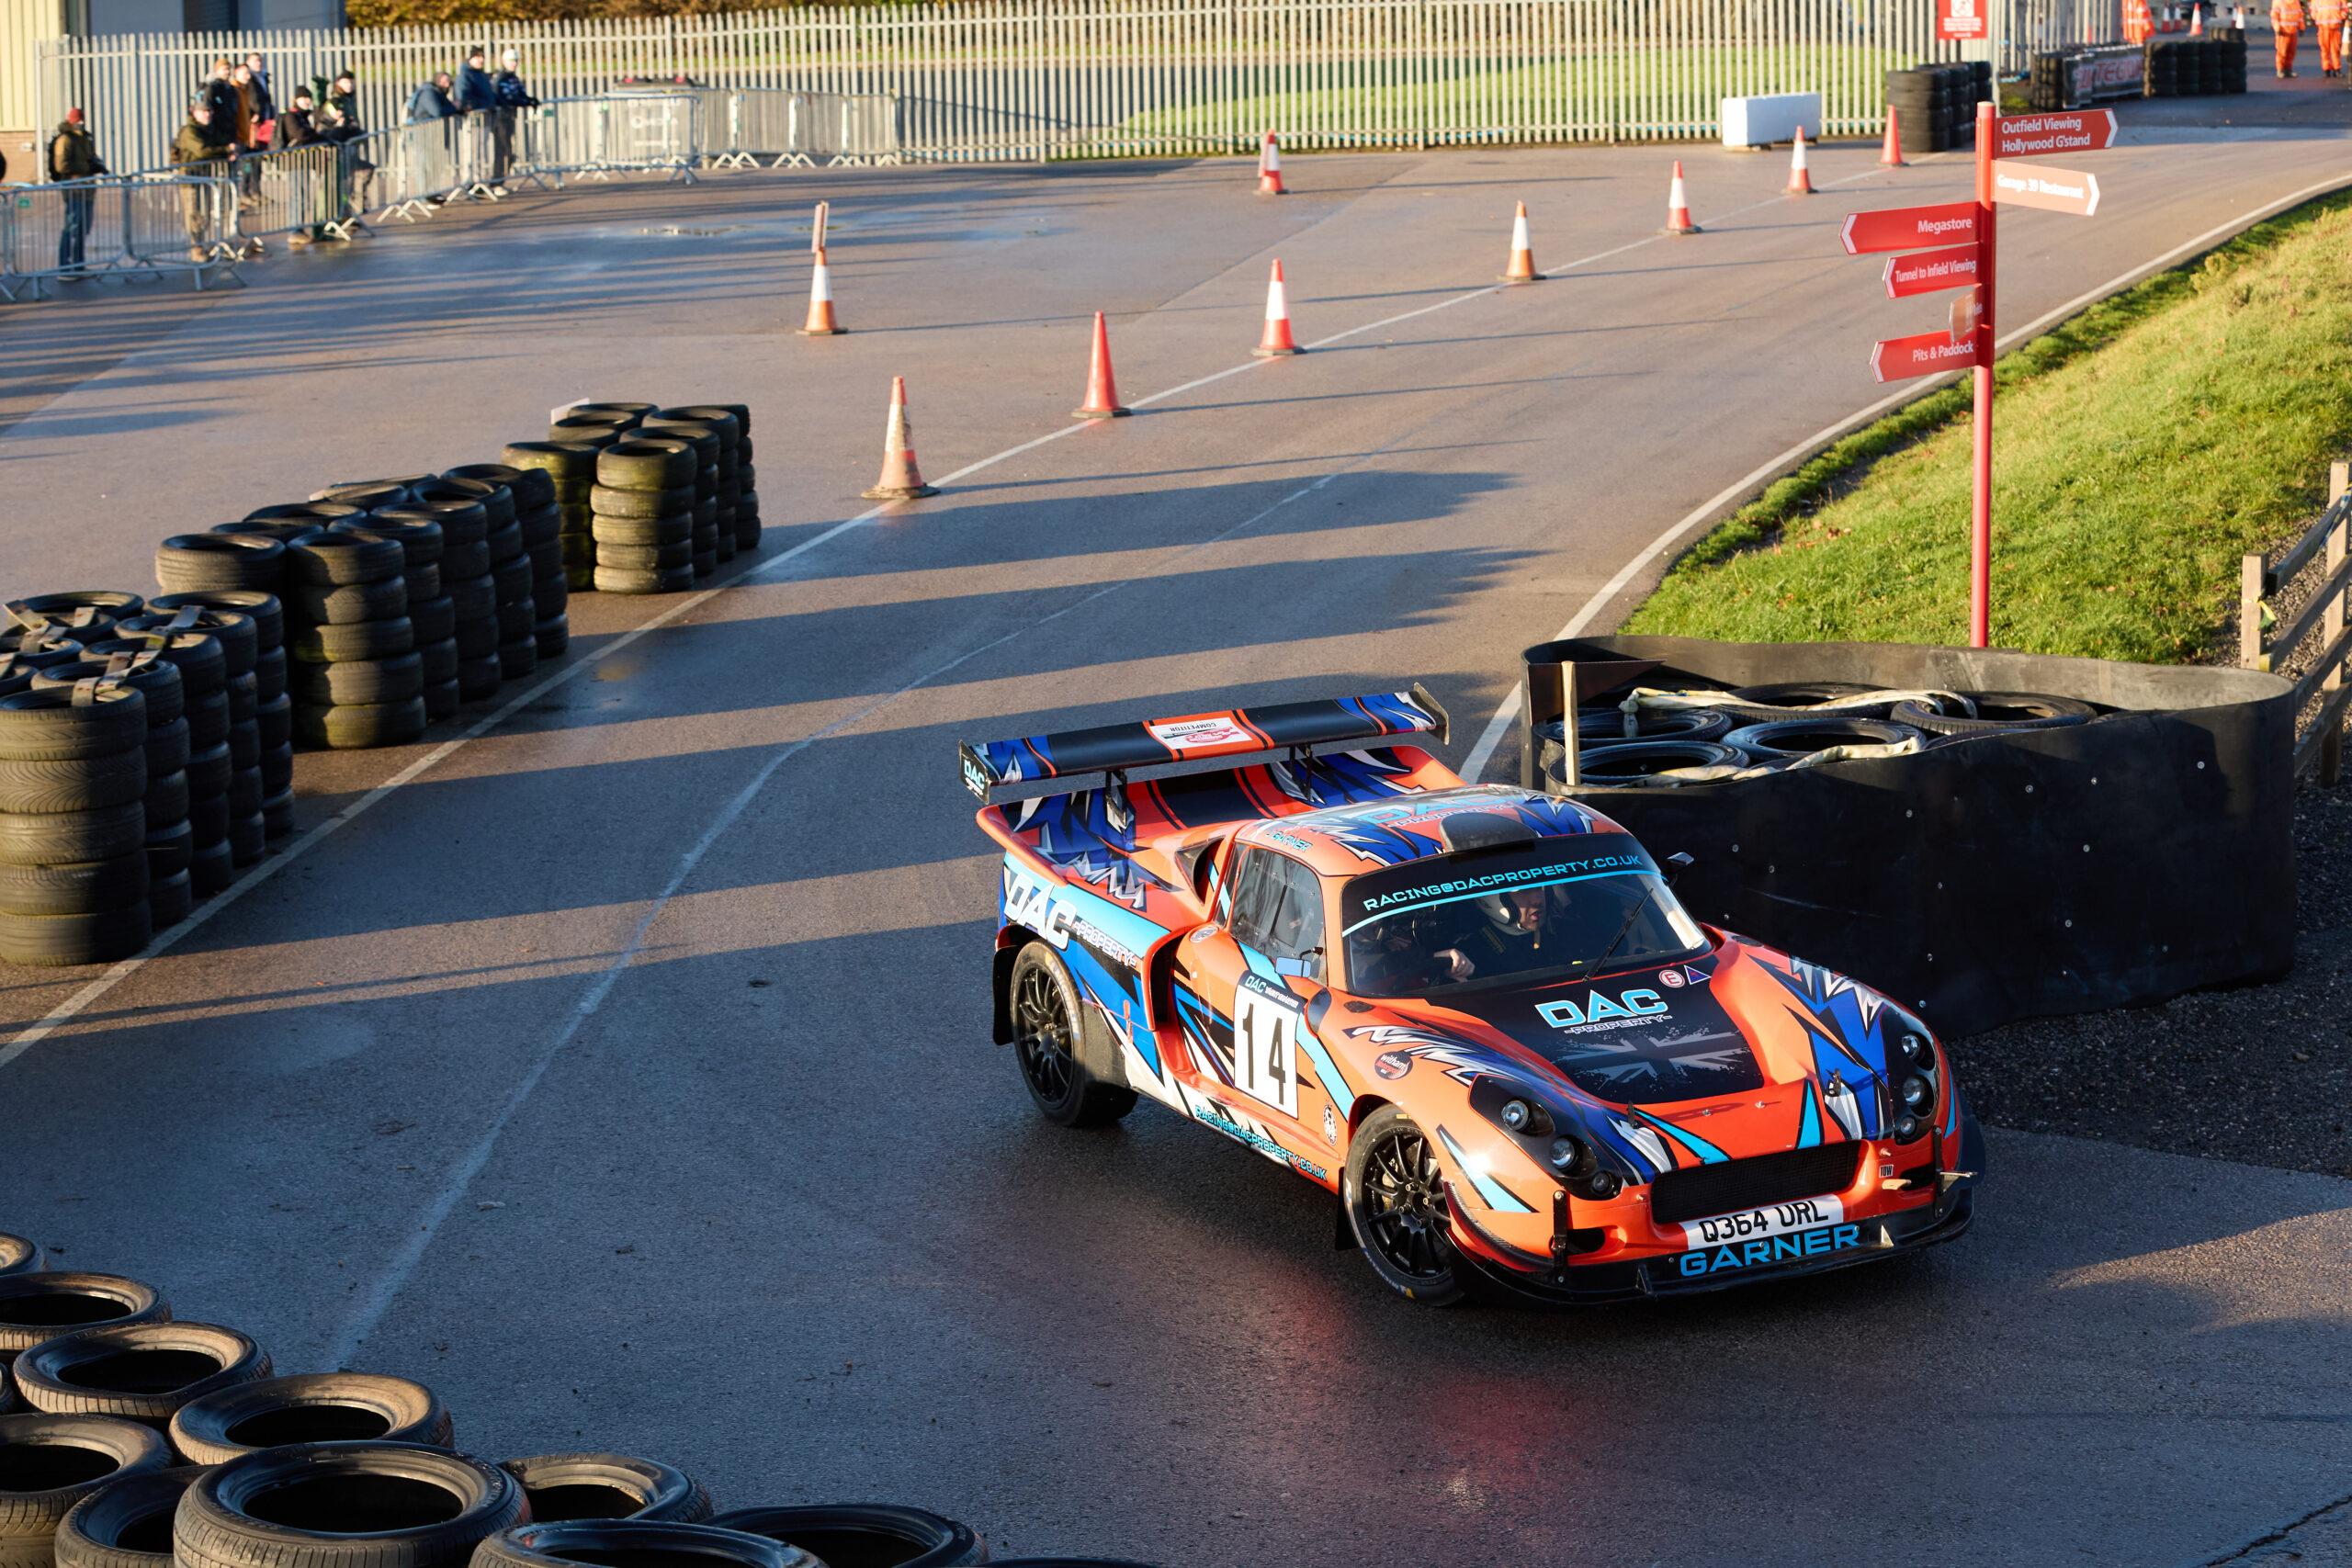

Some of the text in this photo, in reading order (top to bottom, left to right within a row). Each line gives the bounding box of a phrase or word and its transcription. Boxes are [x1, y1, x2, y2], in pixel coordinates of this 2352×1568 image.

[2001, 116, 2082, 135] Outfield Viewing
[2001, 132, 2090, 153] Hollywood G'stand
[1917, 217, 1973, 234] Megastore
[1895, 258, 1976, 283] Tunnel to Infield Viewing
[1913, 340, 1974, 363] Pits & Paddock
[1170, 722, 1217, 732] COMPETITOR
[964, 759, 985, 790] DAC
[1357, 795, 1507, 825] DAC
[1272, 830, 1313, 852] GARNER
[1363, 854, 1644, 911] RACING@DACPROPERTY.CO.UK
[1003, 873, 1078, 951] DAC
[1244, 975, 1267, 994] DAC
[1665, 973, 1679, 985] E
[1534, 988, 1668, 1029] DAC
[1242, 1002, 1286, 1106] 14
[1195, 1104, 1328, 1182] RACING@DACPROPERTY.CO.UK
[1880, 1165, 1894, 1178] TOW
[1699, 1200, 1828, 1242] Q364 URL
[1679, 1224, 1860, 1277] GARNER
